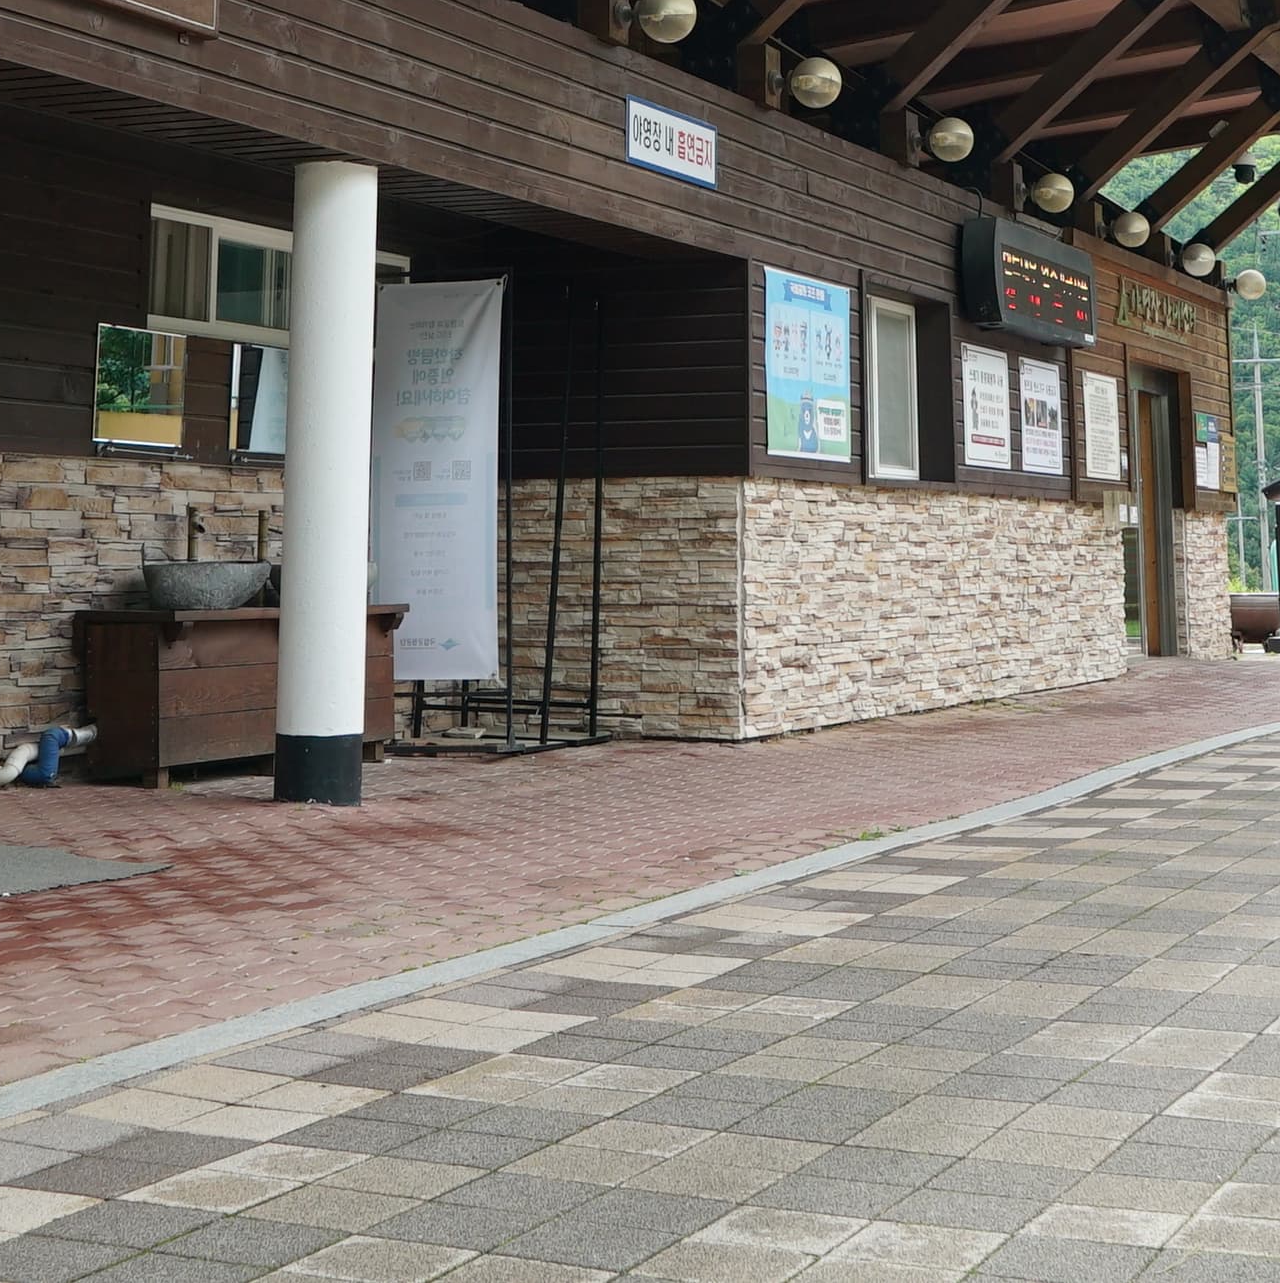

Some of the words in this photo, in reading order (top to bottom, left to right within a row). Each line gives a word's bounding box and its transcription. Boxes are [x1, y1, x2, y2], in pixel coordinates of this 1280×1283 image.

[633, 114, 661, 152] 야영장
[665, 125, 674, 156] 내
[677, 130, 713, 170] 흡연금지
